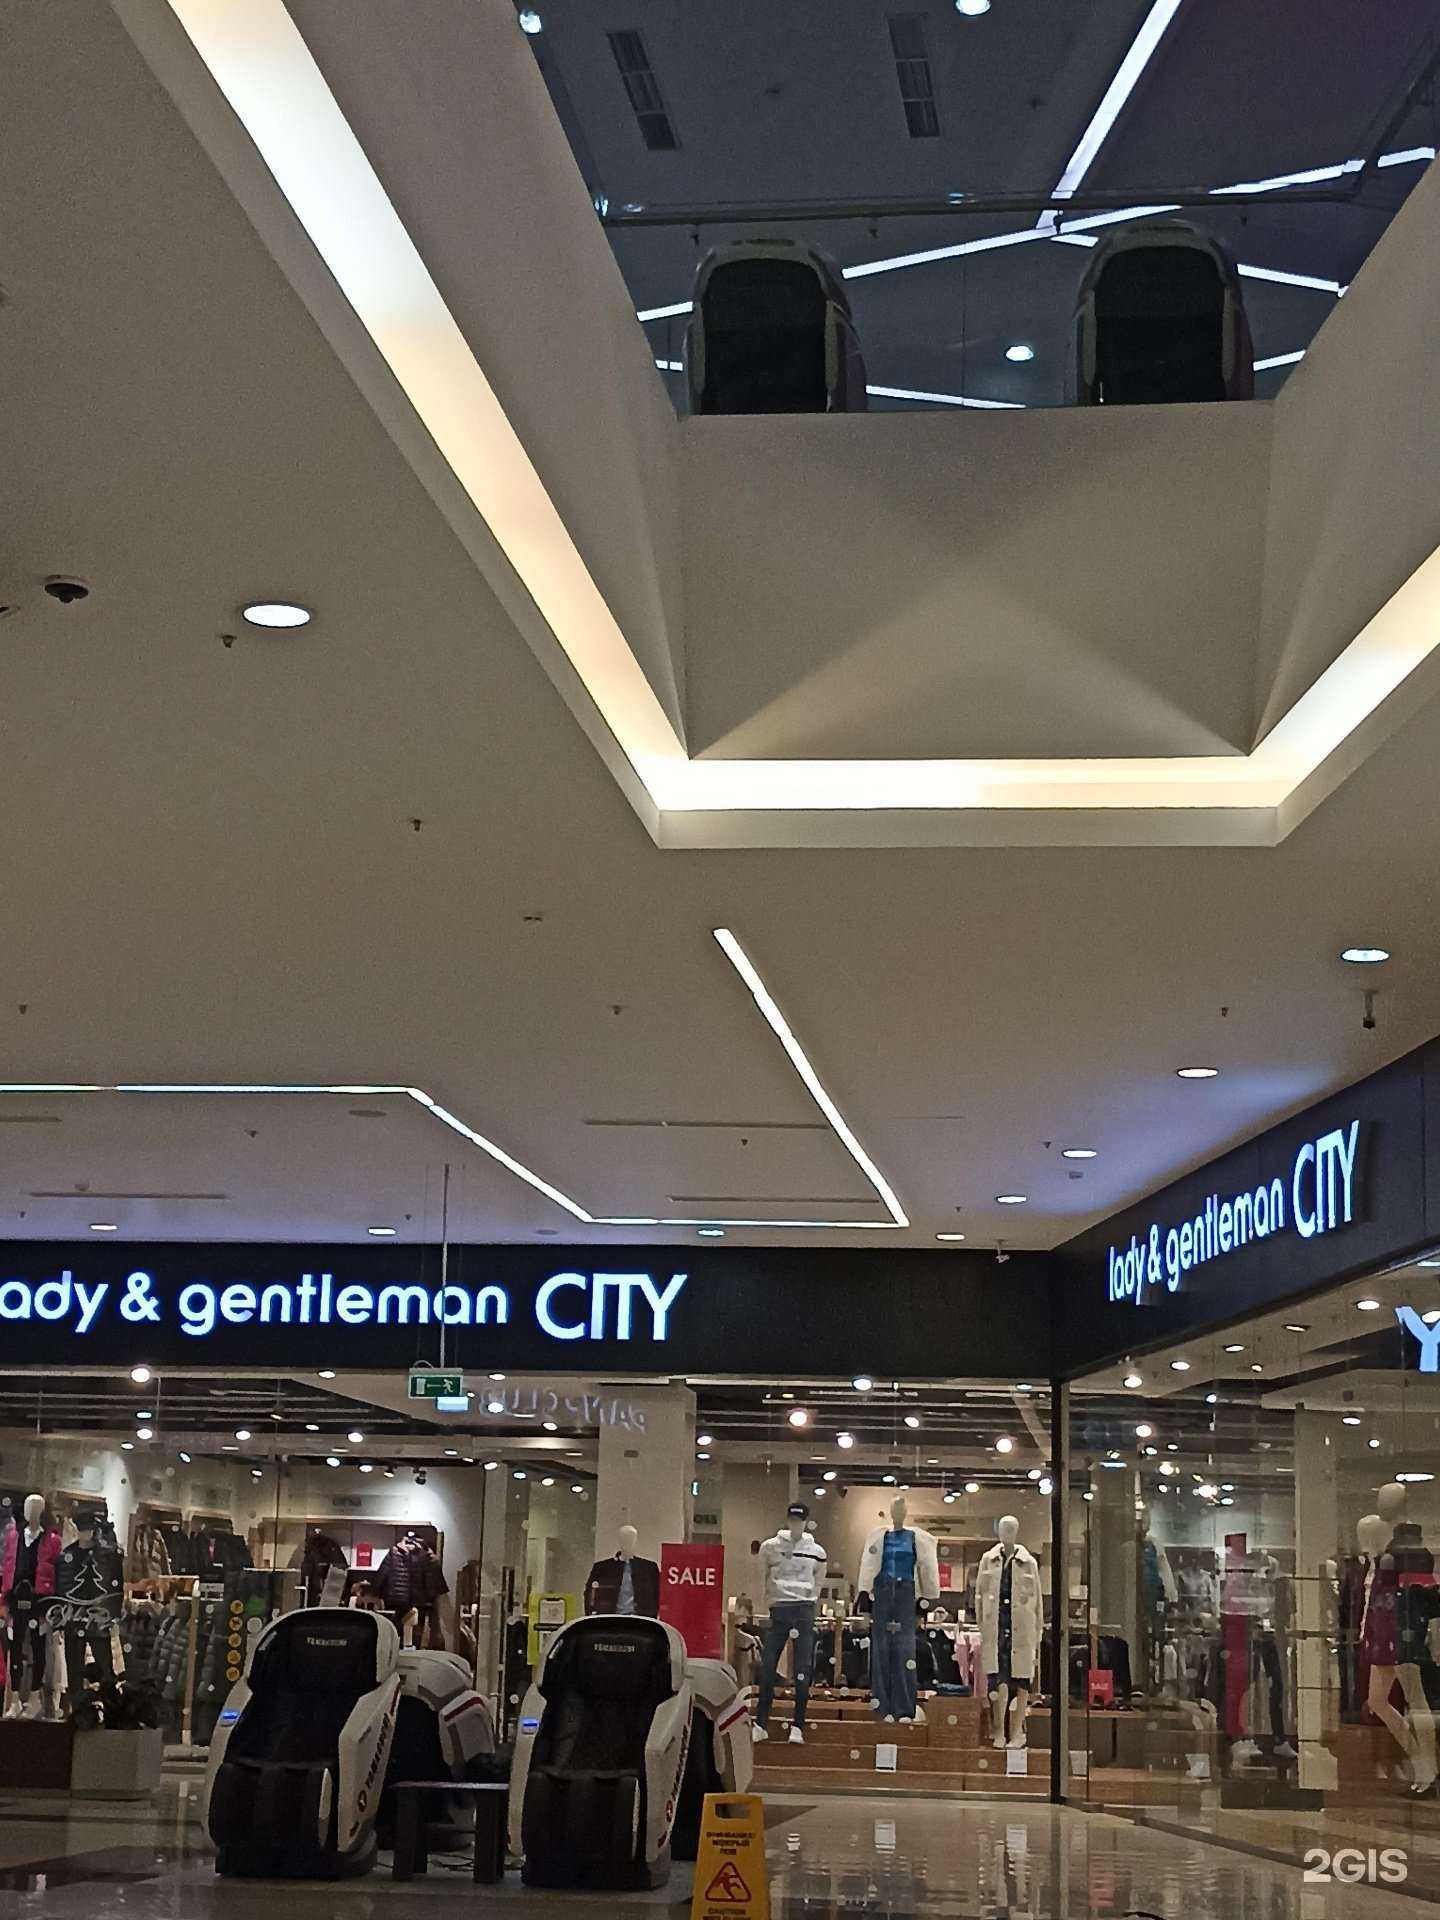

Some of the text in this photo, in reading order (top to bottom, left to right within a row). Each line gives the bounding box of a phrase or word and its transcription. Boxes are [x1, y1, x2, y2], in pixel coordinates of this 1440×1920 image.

[1108, 1119, 1360, 1306] lady & gentleman CITY
[119, 1271, 161, 1322] &
[178, 1273, 509, 1336] gentleman
[535, 1272, 688, 1341] CITY
[667, 1566, 716, 1586] SALE
